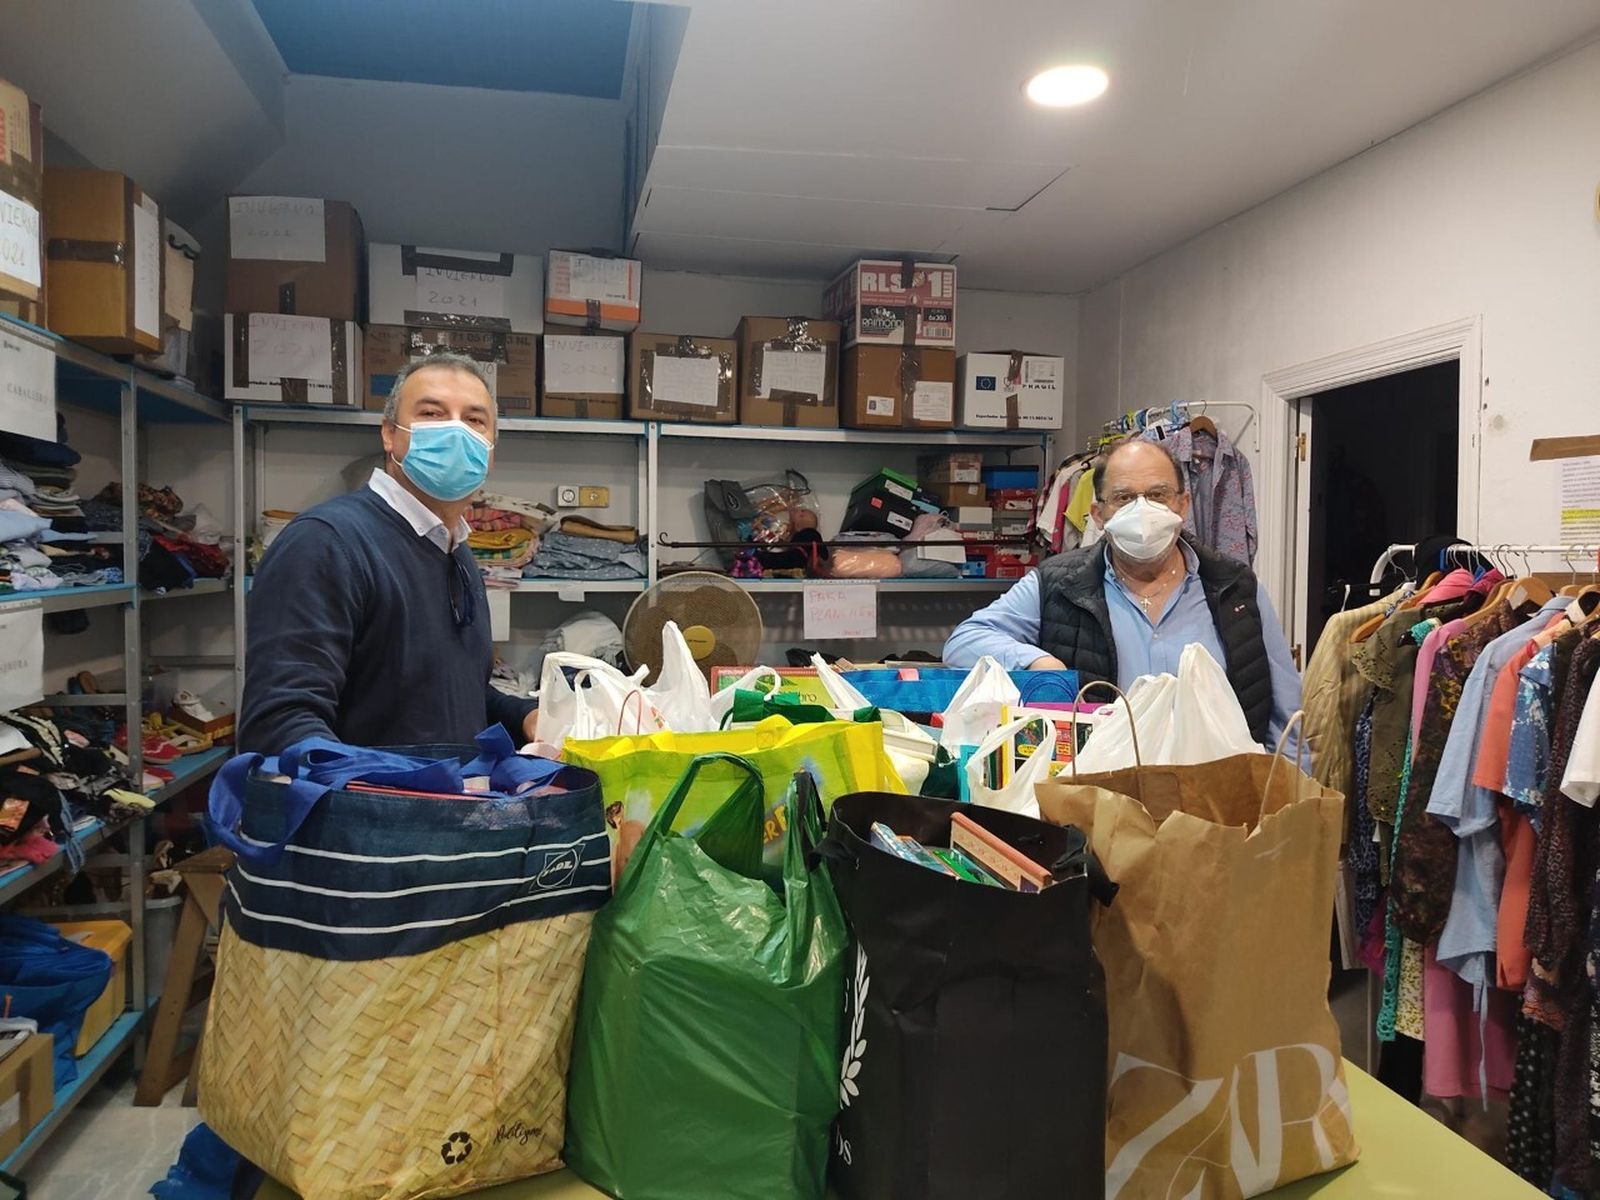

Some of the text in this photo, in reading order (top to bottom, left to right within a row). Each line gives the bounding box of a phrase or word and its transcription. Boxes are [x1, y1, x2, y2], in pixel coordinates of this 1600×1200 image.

[861, 271, 906, 293] RLS
[928, 271, 942, 297] 1
[429, 290, 478, 307] 2021
